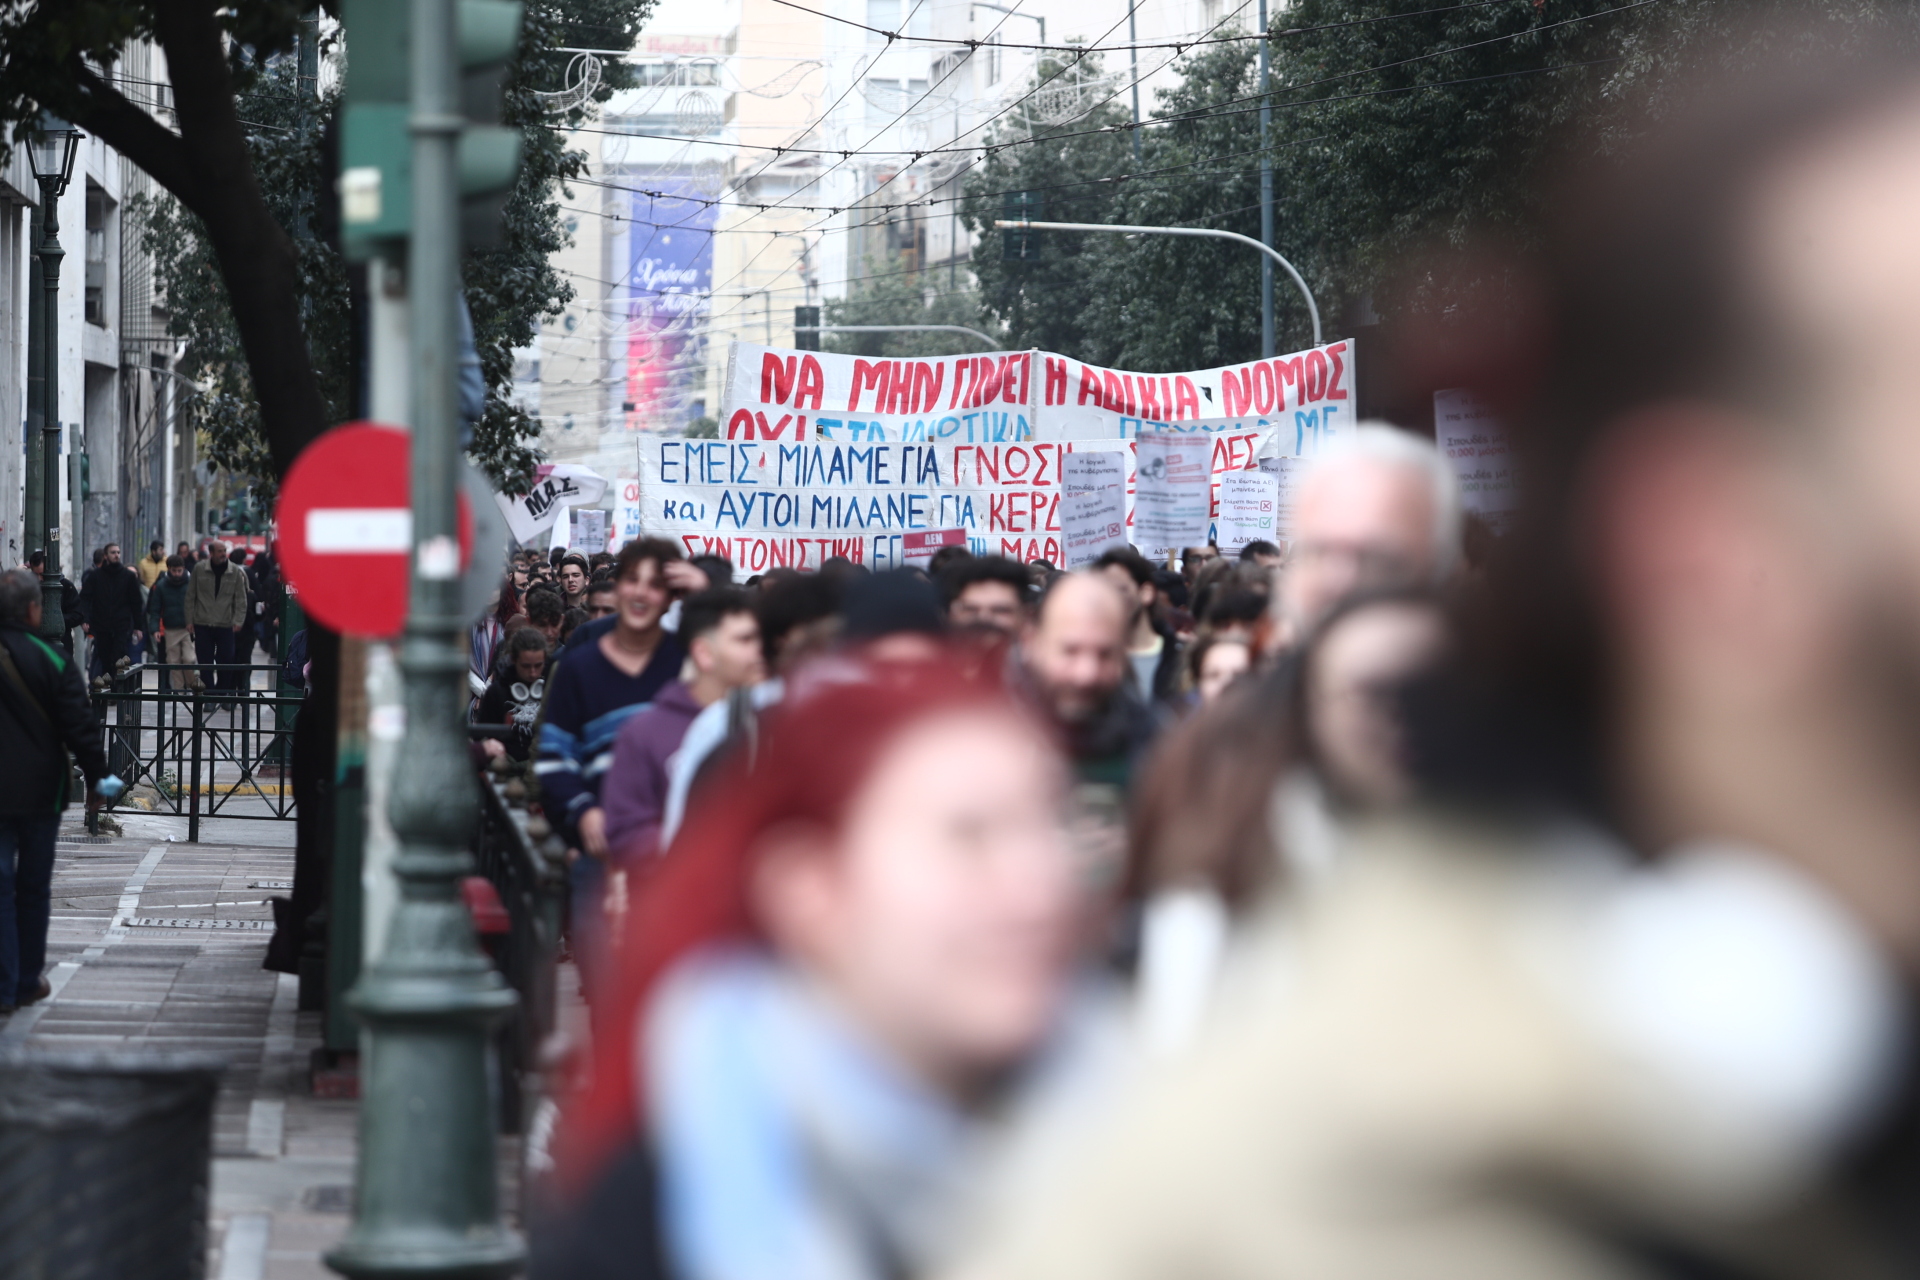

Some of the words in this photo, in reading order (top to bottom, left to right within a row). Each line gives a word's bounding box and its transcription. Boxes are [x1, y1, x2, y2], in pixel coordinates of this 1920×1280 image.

[760, 352, 824, 410] ΝΑ
[847, 358, 944, 415] ΜΗΝ
[949, 352, 1031, 410] ΓΙΝΕΙ
[1045, 356, 1067, 406] Η
[1077, 364, 1200, 422] ΑΔΙΚΙΑ
[1221, 341, 1348, 418] ΝΟΜΟΣ
[1446, 434, 1489, 446] Σπουδές
[661, 442, 759, 484] ΕΜΕΙΣ
[778, 443, 890, 488] ΜΙΛΑΜΕ
[901, 445, 941, 487] ΓΙΑ
[1457, 469, 1492, 481] πουδές
[663, 499, 705, 522] και
[716, 489, 799, 529] ΑΥΤΟΙ
[811, 492, 929, 530] ΜΙΛΑΝΕ
[940, 494, 976, 528] ΓΙΑ
[989, 491, 1062, 533] ΚΕΡΔ
[924, 533, 944, 545] ΔΕΝ
[1067, 528, 1096, 539] Σπουδές
[1067, 538, 1086, 547] 10.000
